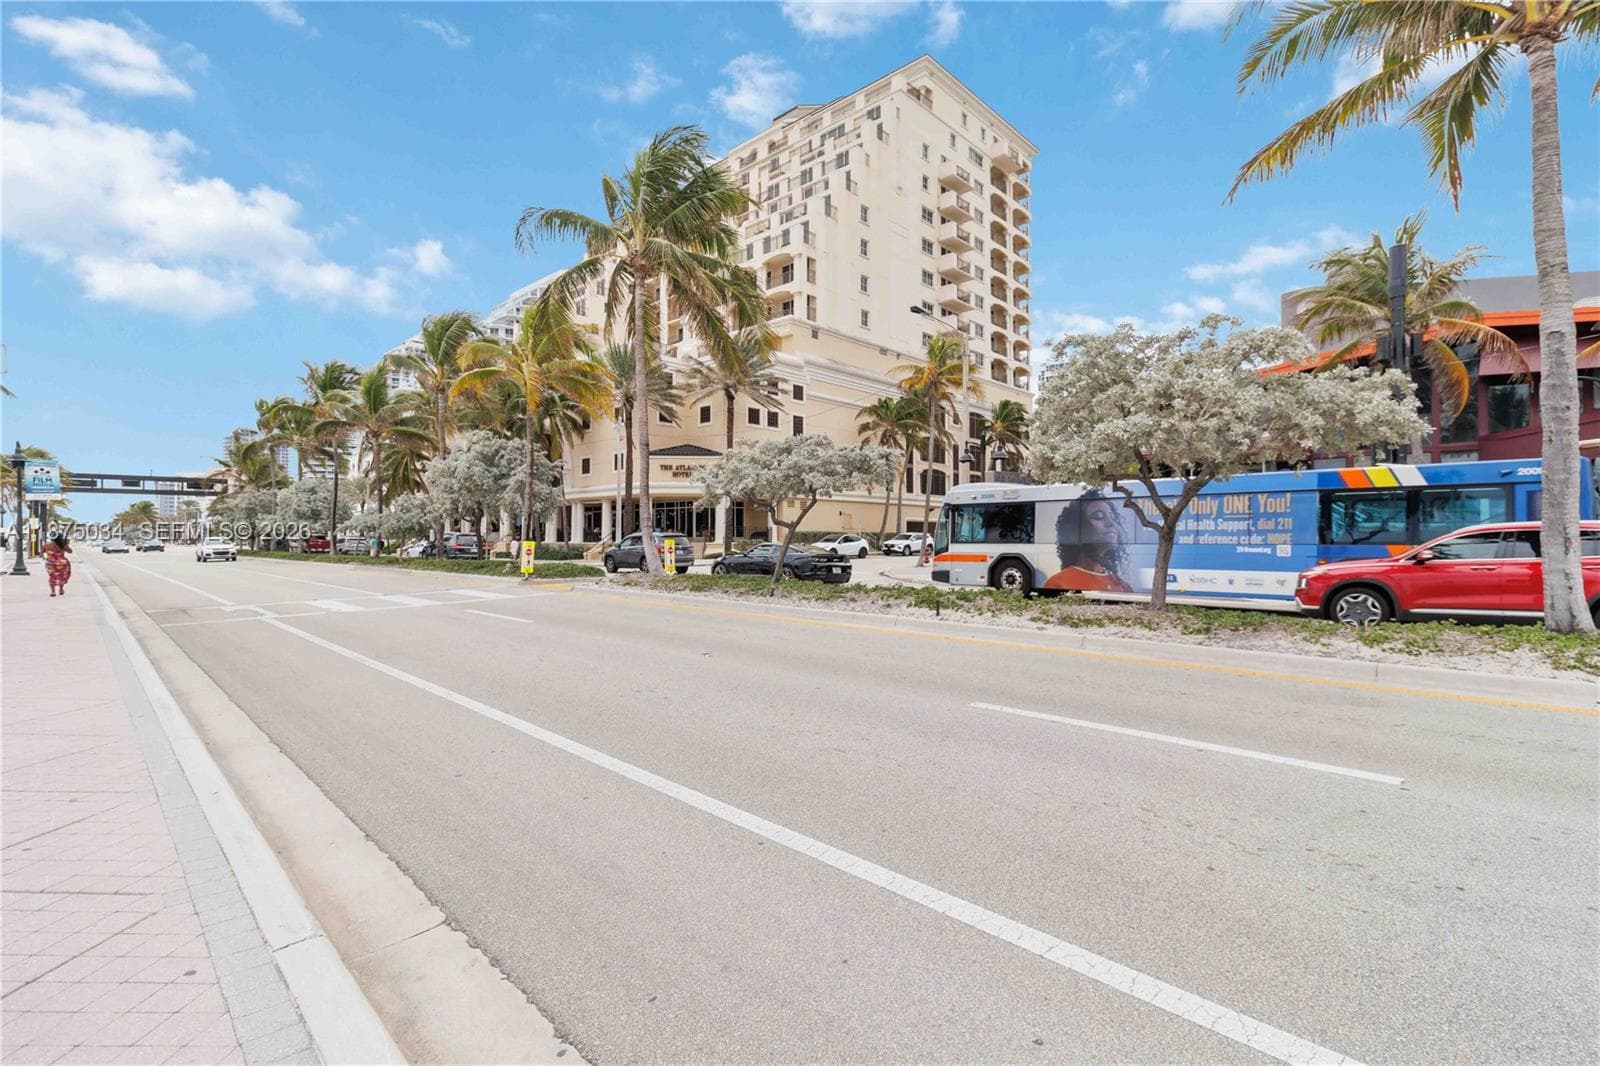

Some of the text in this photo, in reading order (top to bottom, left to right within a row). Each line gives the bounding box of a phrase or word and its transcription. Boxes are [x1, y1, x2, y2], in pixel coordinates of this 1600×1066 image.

[32, 476, 53, 484] FILM
[1190, 496, 1219, 518] Only
[1223, 494, 1252, 514] ONE
[1258, 493, 1291, 513] You!
[1187, 519, 1215, 531] Health
[1217, 518, 1255, 532] Support,
[1257, 518, 1275, 530] dial
[1278, 518, 1293, 530] 211
[1179, 533, 1194, 545] and
[1267, 533, 1293, 544] HOPE
